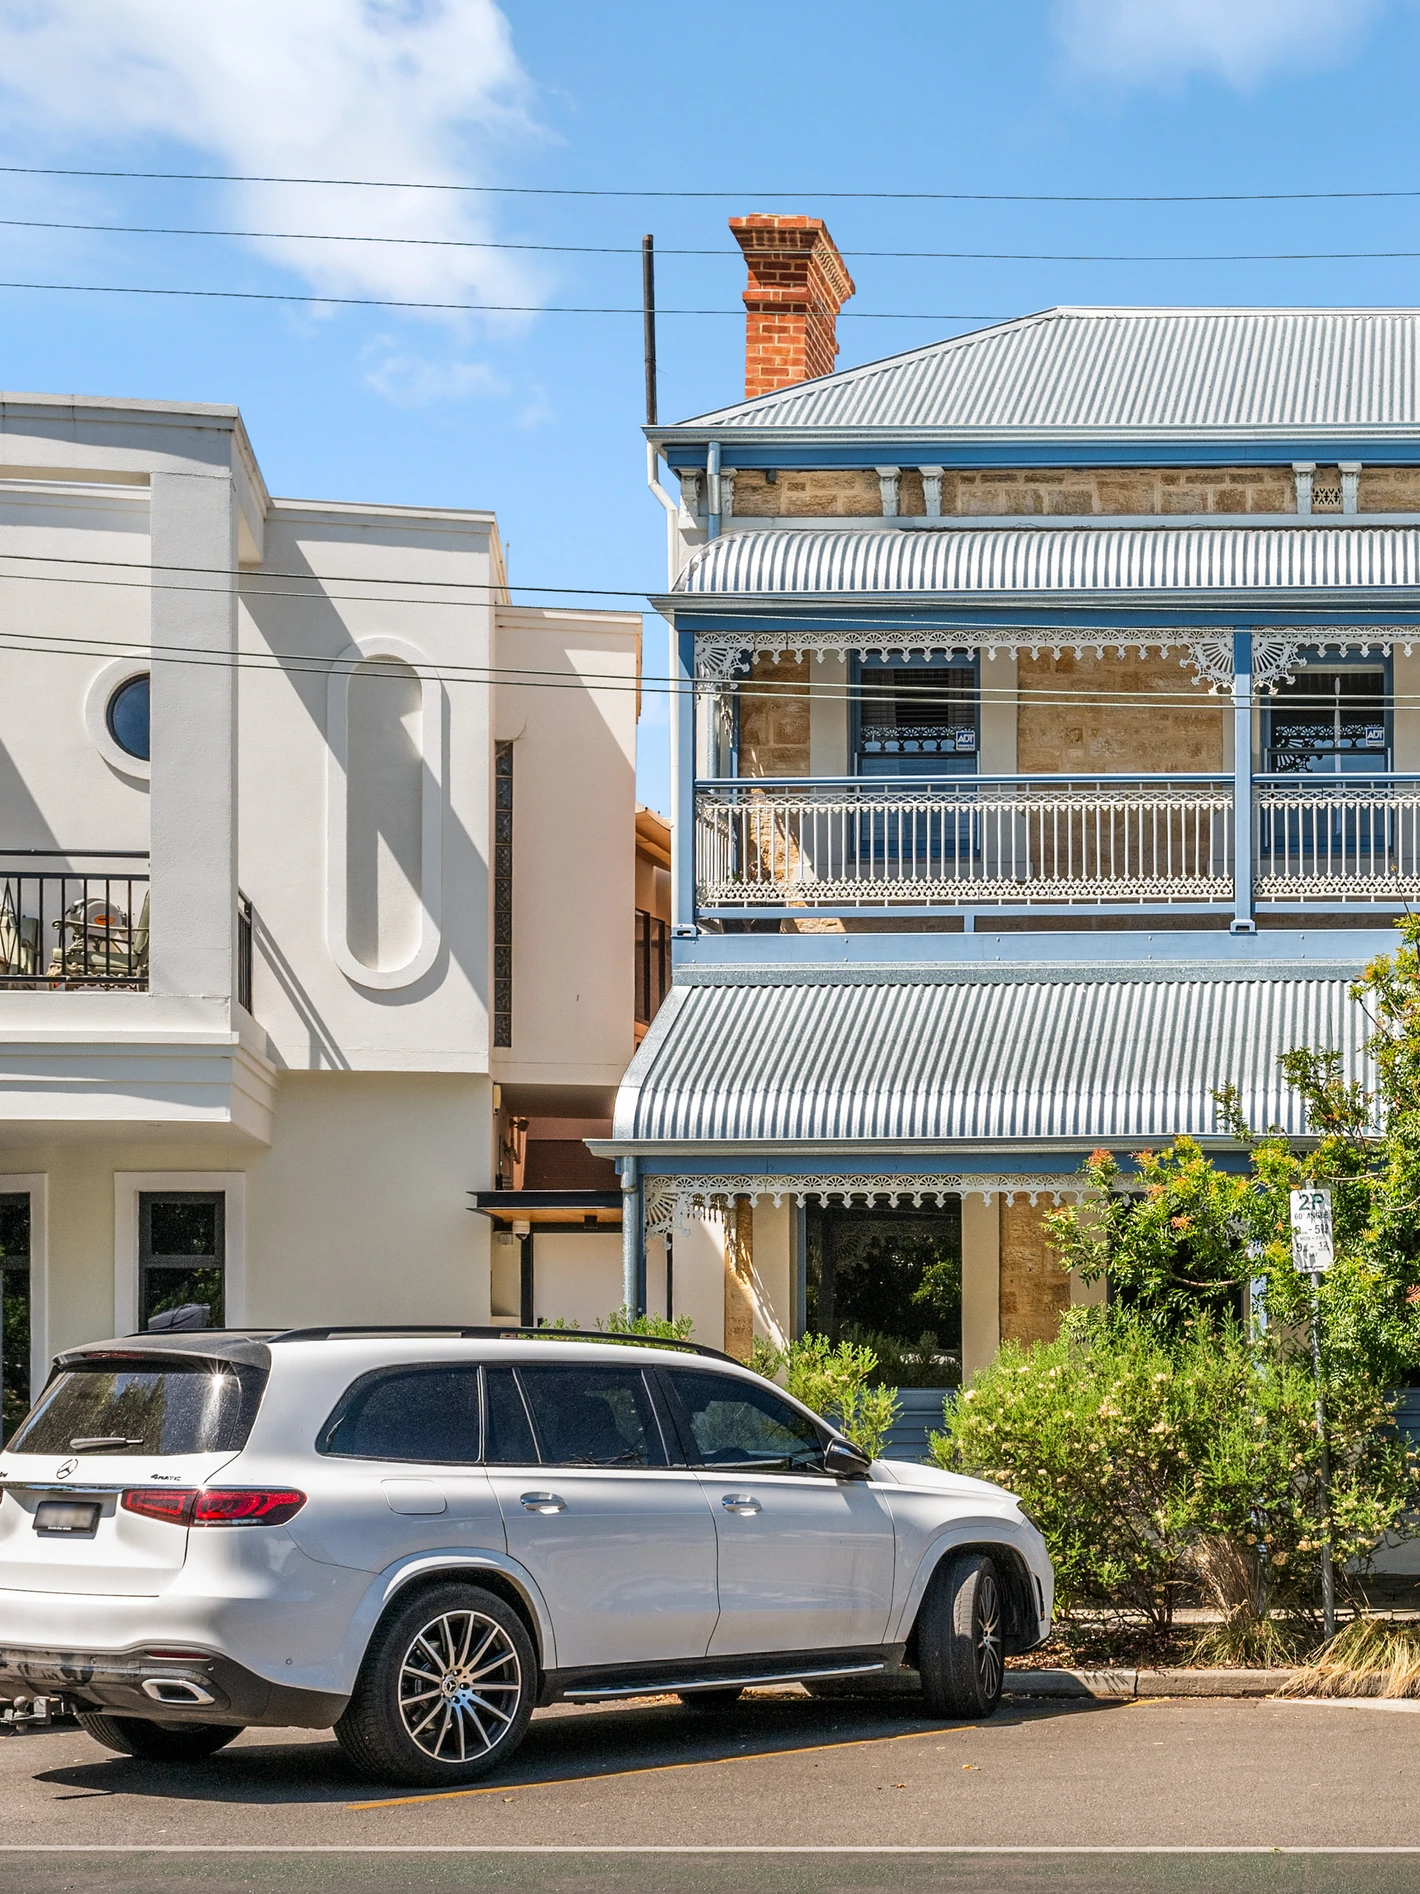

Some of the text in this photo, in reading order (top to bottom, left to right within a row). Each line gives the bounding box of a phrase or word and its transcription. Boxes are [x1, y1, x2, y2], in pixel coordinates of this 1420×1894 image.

[958, 734, 973, 743] ADT
[1367, 730, 1383, 739] ADT
[1299, 1193, 1325, 1211] 2P
[1306, 1211, 1329, 1220] ANGLE
